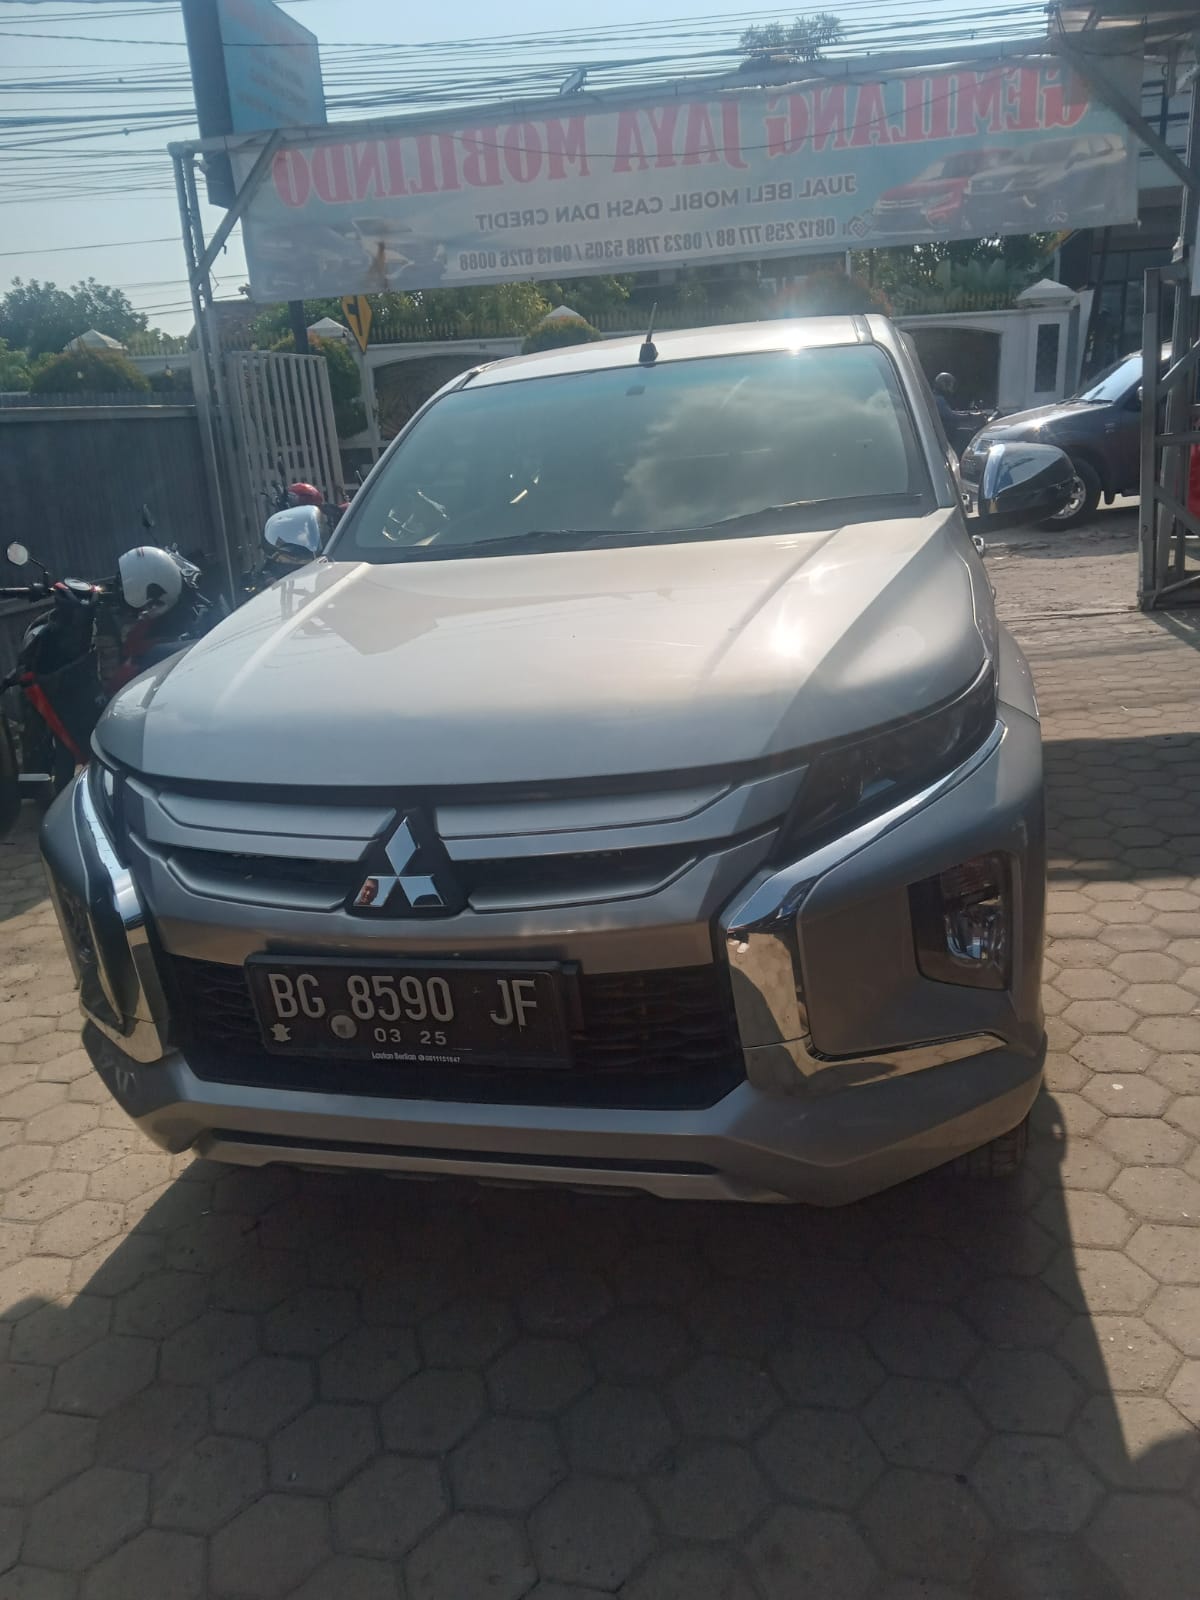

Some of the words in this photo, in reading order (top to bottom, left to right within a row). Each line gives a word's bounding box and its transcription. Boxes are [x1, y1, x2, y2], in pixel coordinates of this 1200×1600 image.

[268, 973, 326, 1019] BG
[347, 975, 454, 1022] 8590
[490, 979, 537, 1030] JF
[373, 1027, 402, 1043] 03
[420, 1029, 448, 1046] 25
